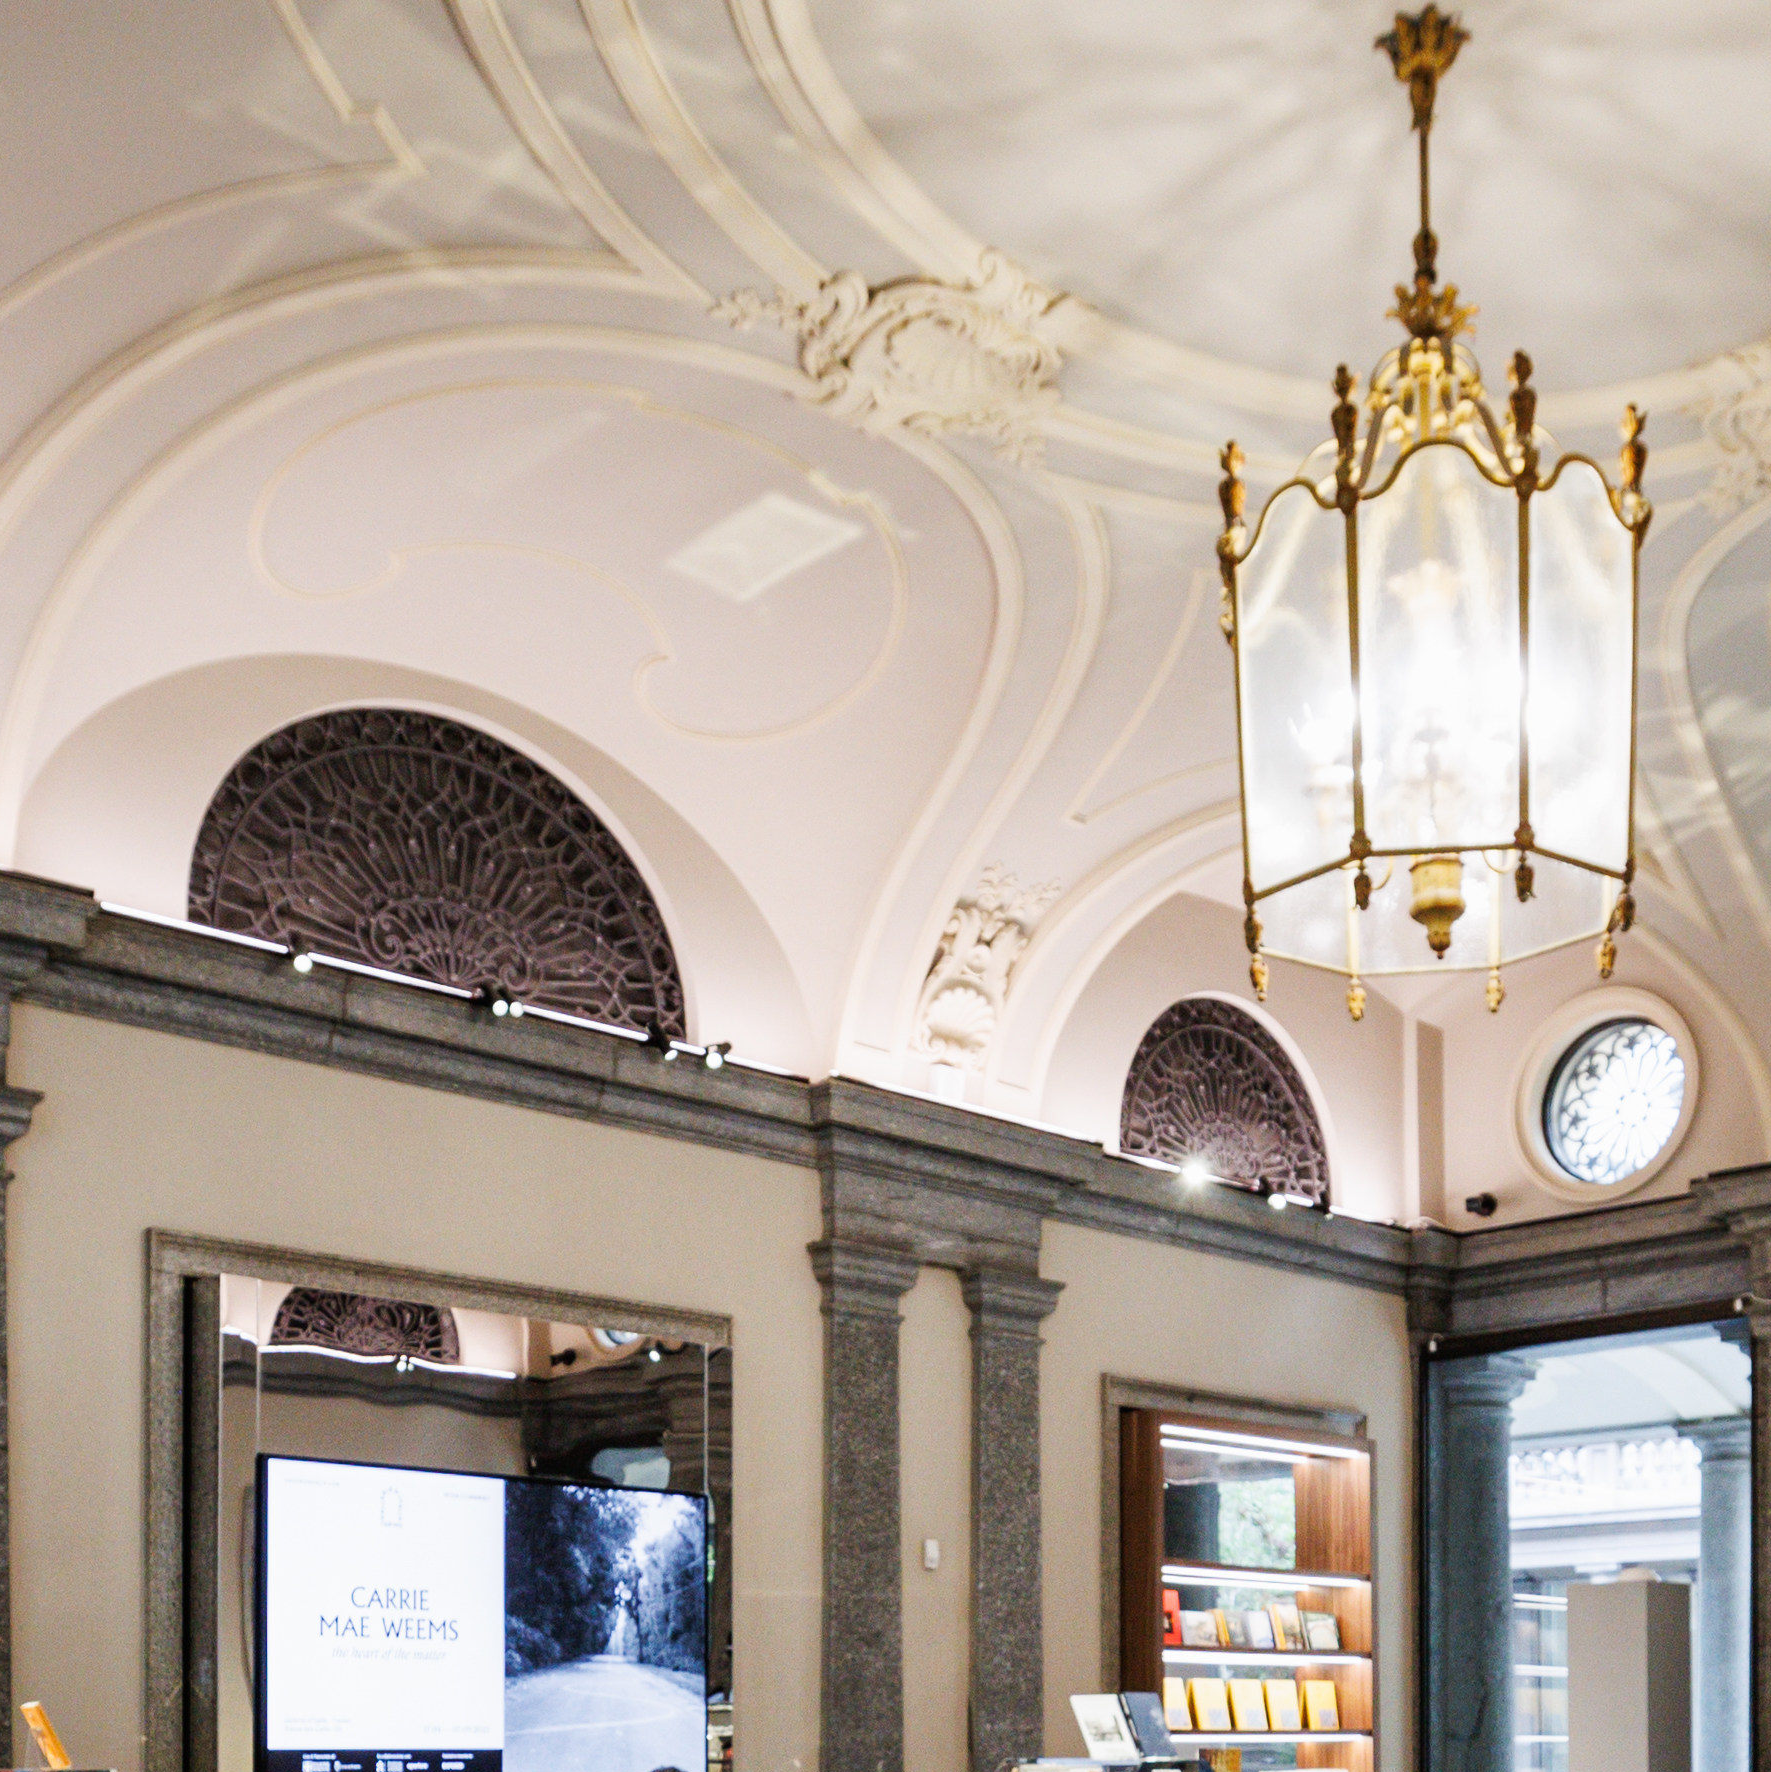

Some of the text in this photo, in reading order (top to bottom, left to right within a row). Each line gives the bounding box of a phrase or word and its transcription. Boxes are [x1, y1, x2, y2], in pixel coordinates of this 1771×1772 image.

[351, 1586, 429, 1611] CARRIE
[320, 1615, 459, 1641] MAE WEEMS
